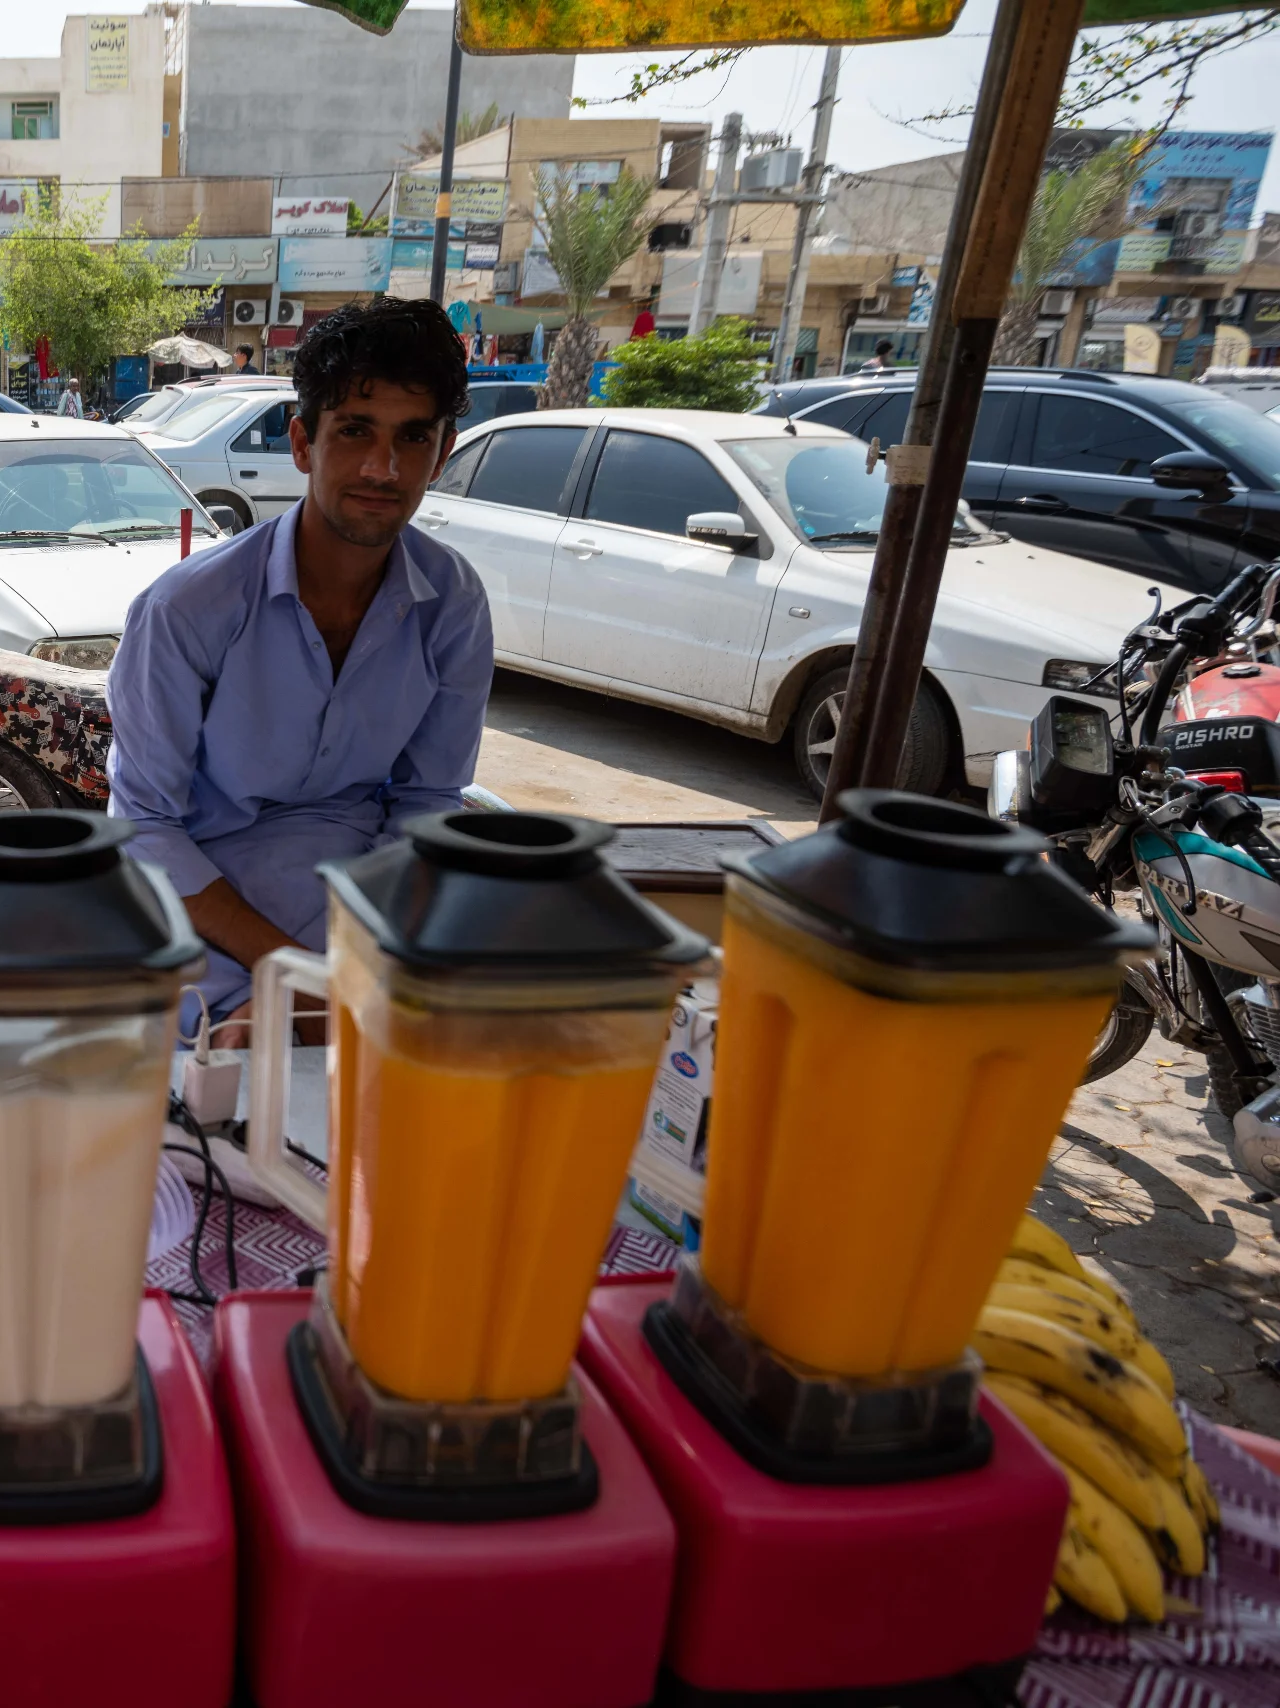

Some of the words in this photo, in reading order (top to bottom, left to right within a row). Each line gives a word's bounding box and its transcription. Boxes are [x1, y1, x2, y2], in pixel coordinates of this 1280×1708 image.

[90, 35, 125, 52] آپارتمان
[275, 201, 312, 218] کویر
[314, 200, 348, 214] املاک
[1175, 725, 1254, 746] PISHRO
